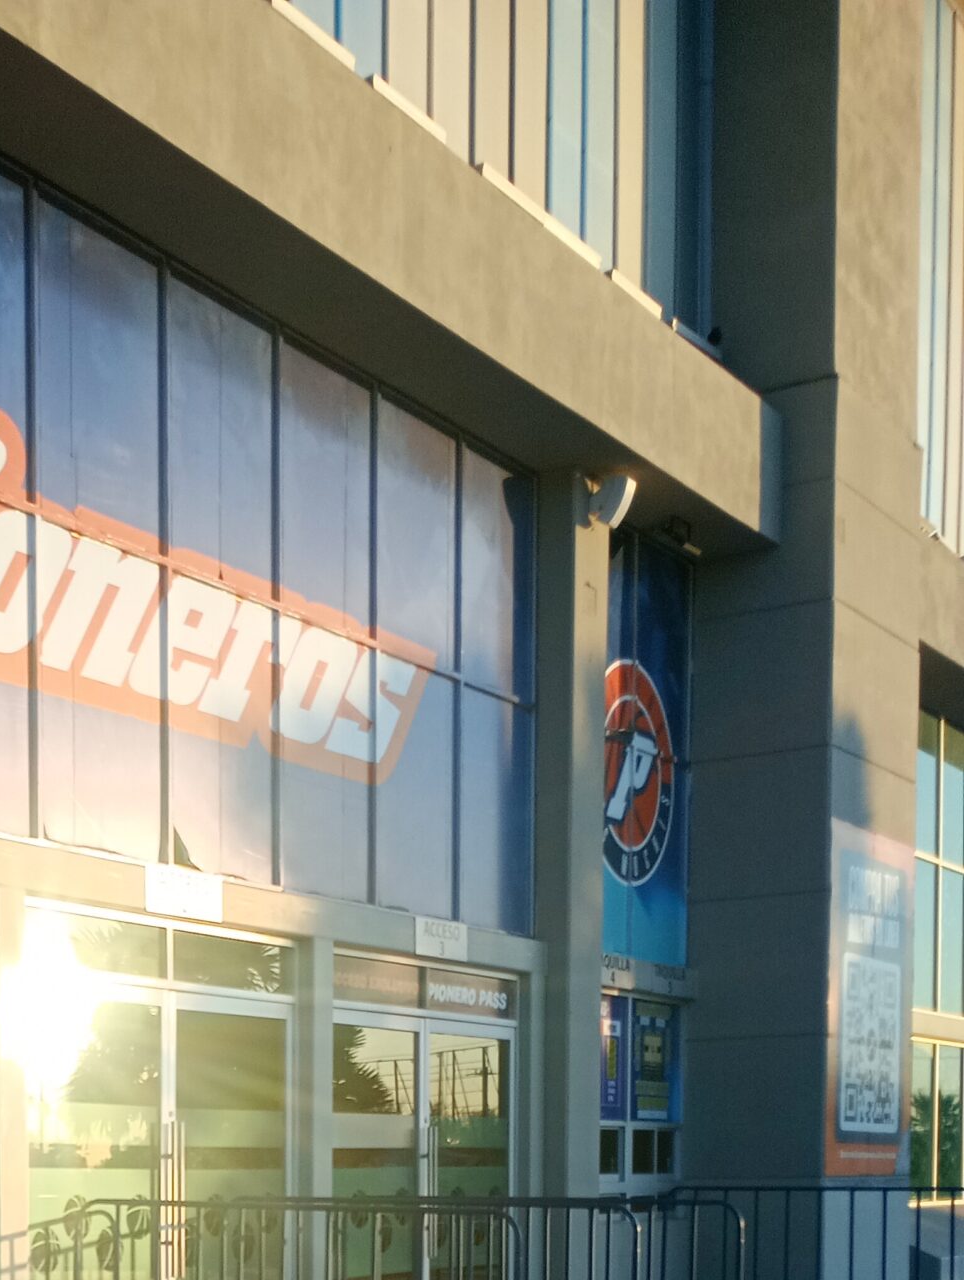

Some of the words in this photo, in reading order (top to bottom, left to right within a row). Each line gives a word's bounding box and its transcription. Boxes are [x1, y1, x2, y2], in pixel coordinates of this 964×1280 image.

[423, 921, 460, 941] ACCESO
[427, 983, 477, 1006] PIONERO
[478, 989, 508, 1010] PASS
